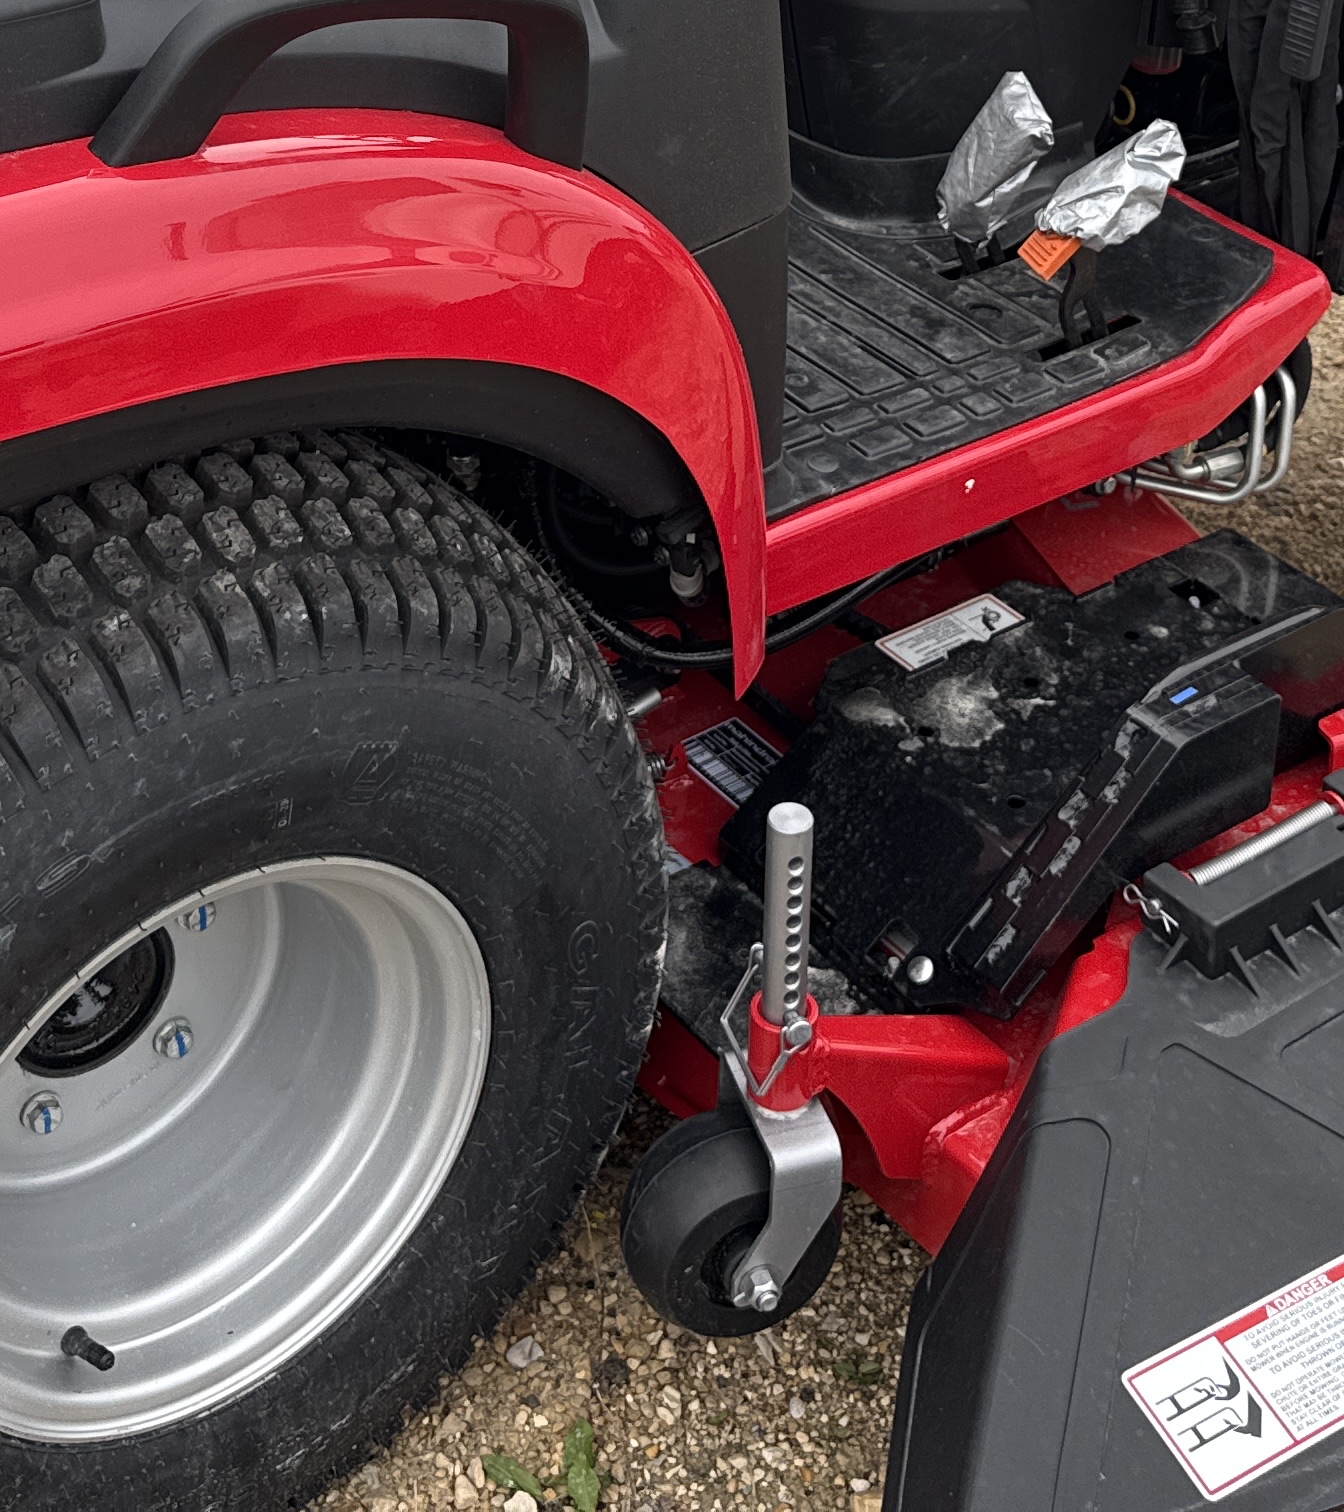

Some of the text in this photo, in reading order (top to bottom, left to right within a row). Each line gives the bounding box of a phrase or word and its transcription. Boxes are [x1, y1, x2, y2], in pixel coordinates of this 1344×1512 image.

[1254, 1317, 1280, 1335] AVOID
[1278, 1299, 1313, 1321] SERIOUS
[1312, 1285, 1340, 1303] INJURY
[1275, 1273, 1332, 1312] DANGER
[1244, 1355, 1257, 1365] DO
[1256, 1347, 1271, 1359] NOT
[1270, 1339, 1286, 1351] PUT
[1319, 1311, 1338, 1323] FEET
[1250, 1323, 1291, 1348] SEVERING
[1288, 1317, 1302, 1327] OF
[1301, 1305, 1323, 1320] TOES
[1321, 1298, 1335, 1309] OR
[1268, 1363, 1282, 1375] TO
[1280, 1350, 1307, 1368] AVOID
[1305, 1331, 1341, 1354] SERIOUS
[1300, 1345, 1336, 1369] THROWN
[1269, 1388, 1282, 1398] DO
[1280, 1380, 1296, 1392] NOT
[1294, 1364, 1325, 1384] OPERATE
[1289, 1411, 1308, 1425] STAY
[1307, 1398, 1332, 1415] CLEAR
